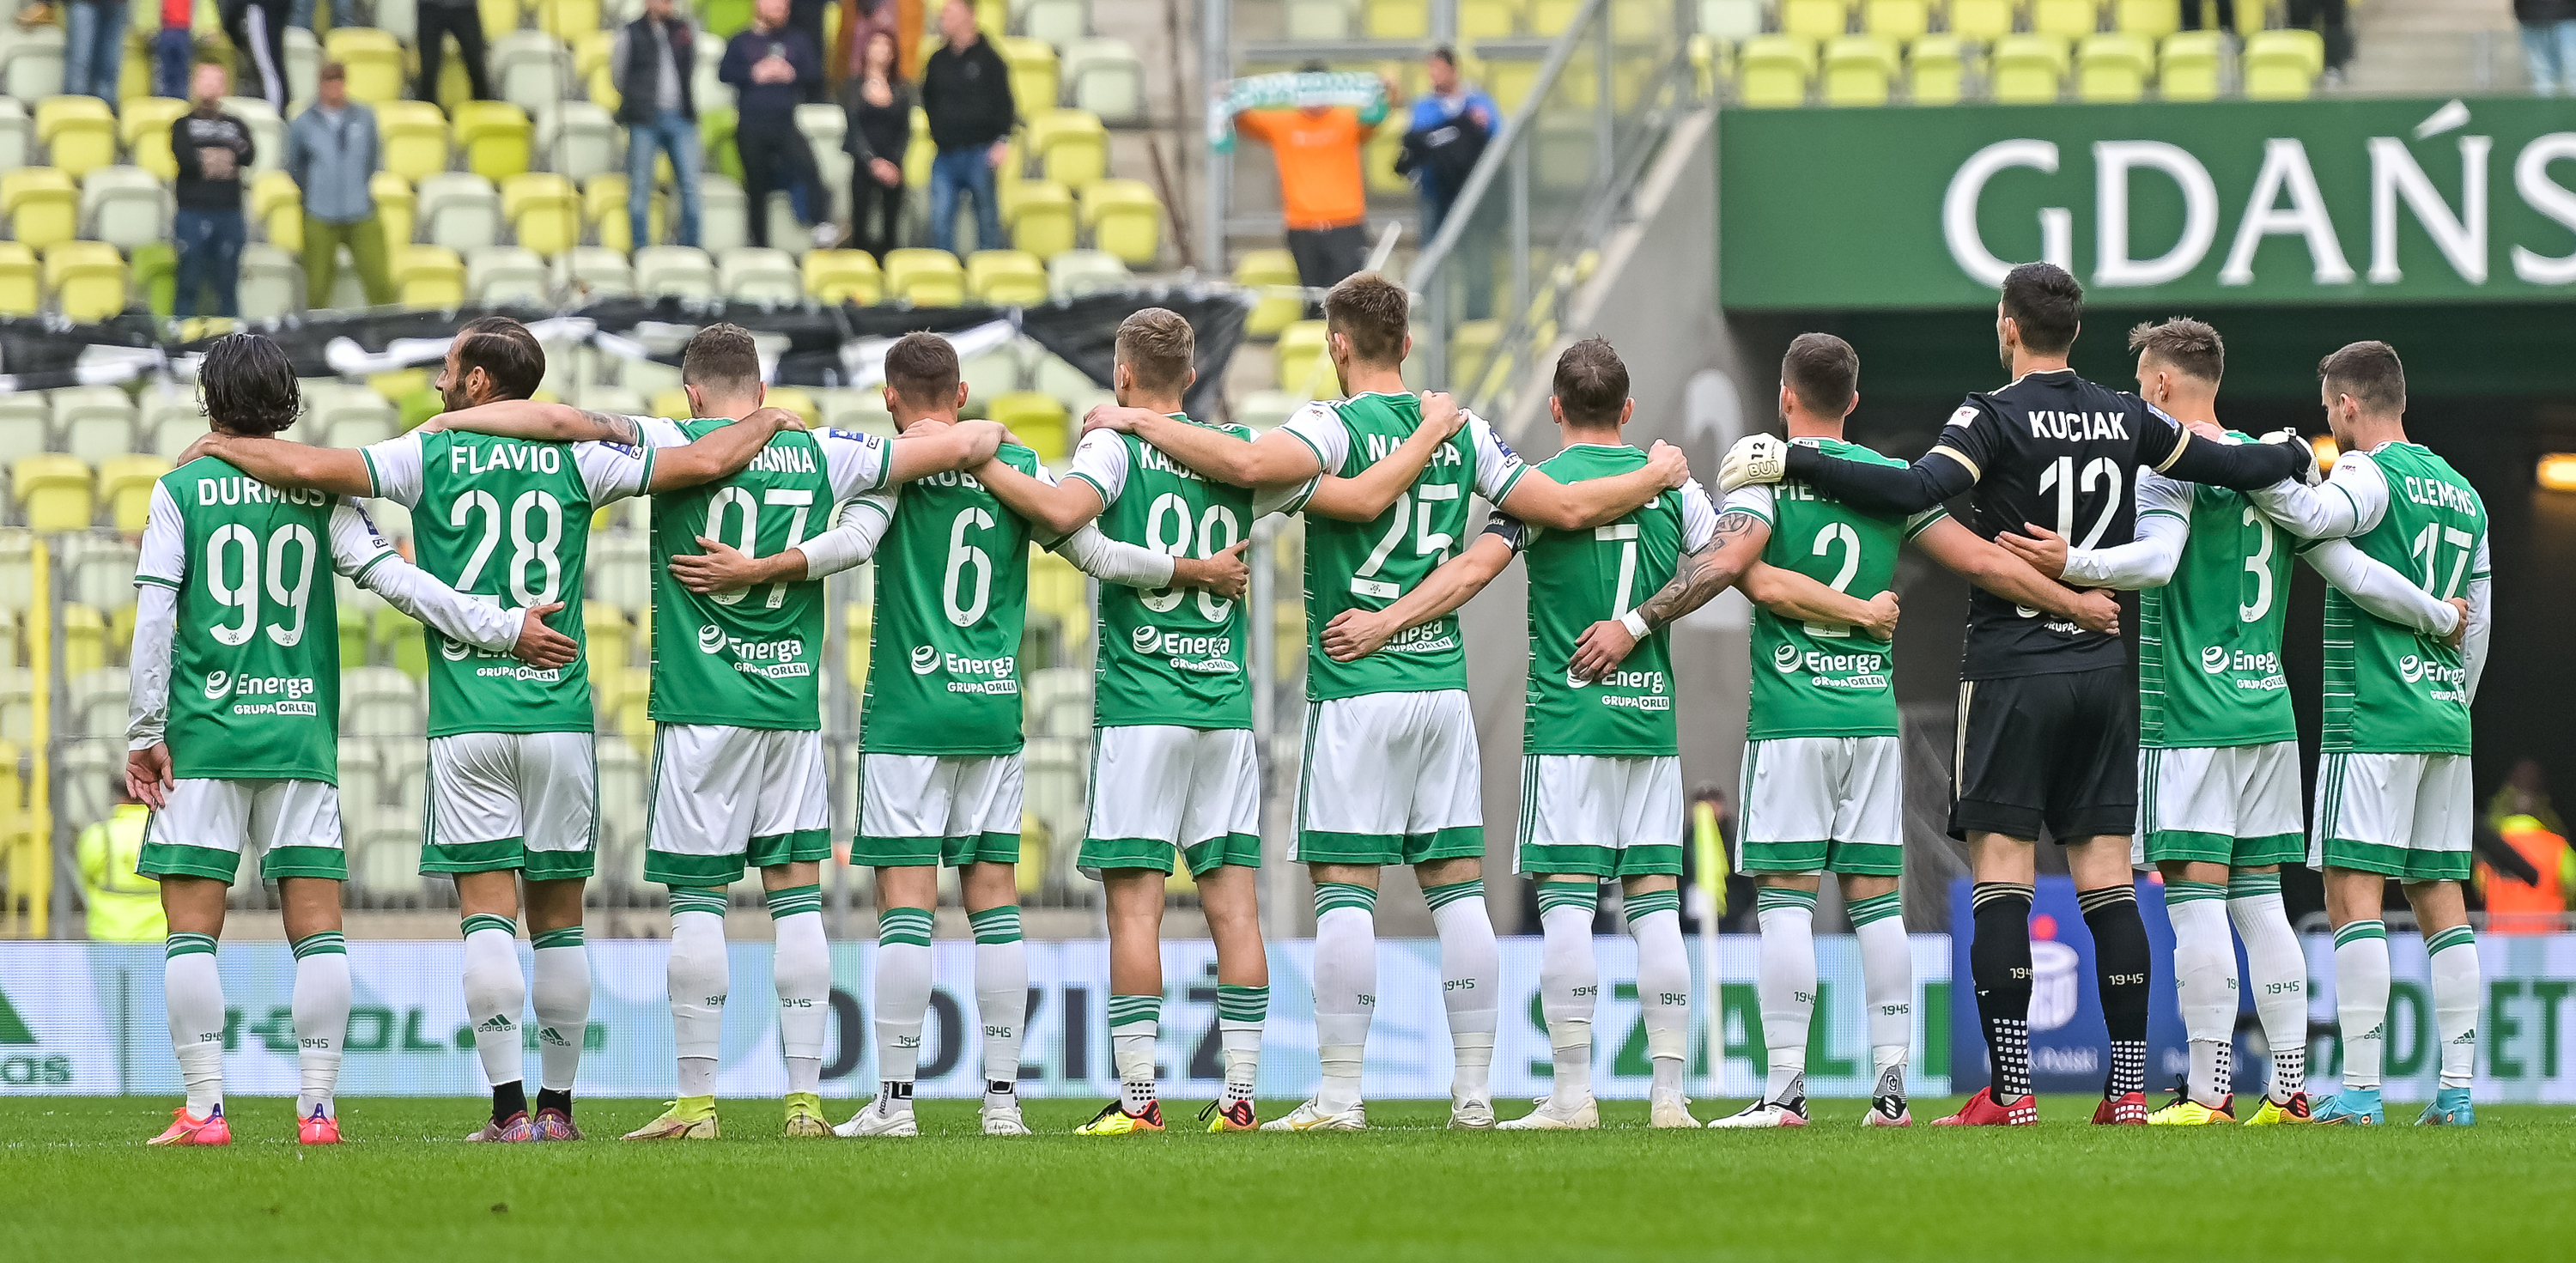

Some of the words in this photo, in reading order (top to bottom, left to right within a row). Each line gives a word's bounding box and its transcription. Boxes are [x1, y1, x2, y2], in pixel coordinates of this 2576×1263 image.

[1942, 99, 2576, 288] GDAŃS
[2028, 410, 2129, 442] KUCIAK
[451, 443, 561, 475] FLAVIO
[1368, 433, 1461, 469] NAPA
[1751, 441, 1766, 459] 12
[2038, 456, 2123, 551] 12
[2405, 476, 2477, 517] CLEMENS
[450, 489, 563, 608] 28
[1350, 483, 1460, 600] 25
[943, 507, 996, 628] 6
[1595, 523, 1638, 622] 7
[2239, 505, 2273, 623] 3
[2412, 522, 2474, 604] 17
[206, 523, 318, 647] 99
[1803, 521, 1861, 637] 2
[477, 666, 516, 677] GRUPA
[771, 664, 808, 676] ORLEN
[945, 653, 1016, 678] Energa
[1806, 651, 1882, 674] Energa
[235, 673, 314, 699] Energa
[947, 681, 985, 694] GRUPA
[1601, 666, 1666, 694] Energ
[1851, 677, 1884, 686] ORLEN
[234, 703, 276, 715] GRUPA
[278, 702, 315, 714] ORLEN
[1601, 695, 1639, 707] GRUPA
[2010, 968, 2033, 980] 194
[2109, 973, 2144, 986] 1945
[1444, 978, 1476, 992] 1945
[2266, 981, 2300, 995] 1945
[781, 998, 812, 1008] 1945
[1358, 993, 1376, 1007] 194
[1660, 993, 1686, 1006] 1945
[1882, 1004, 1909, 1016] 1945
[477, 1022, 517, 1033] adidas
[985, 1025, 1012, 1038] 1945
[301, 1037, 330, 1048] 1945
